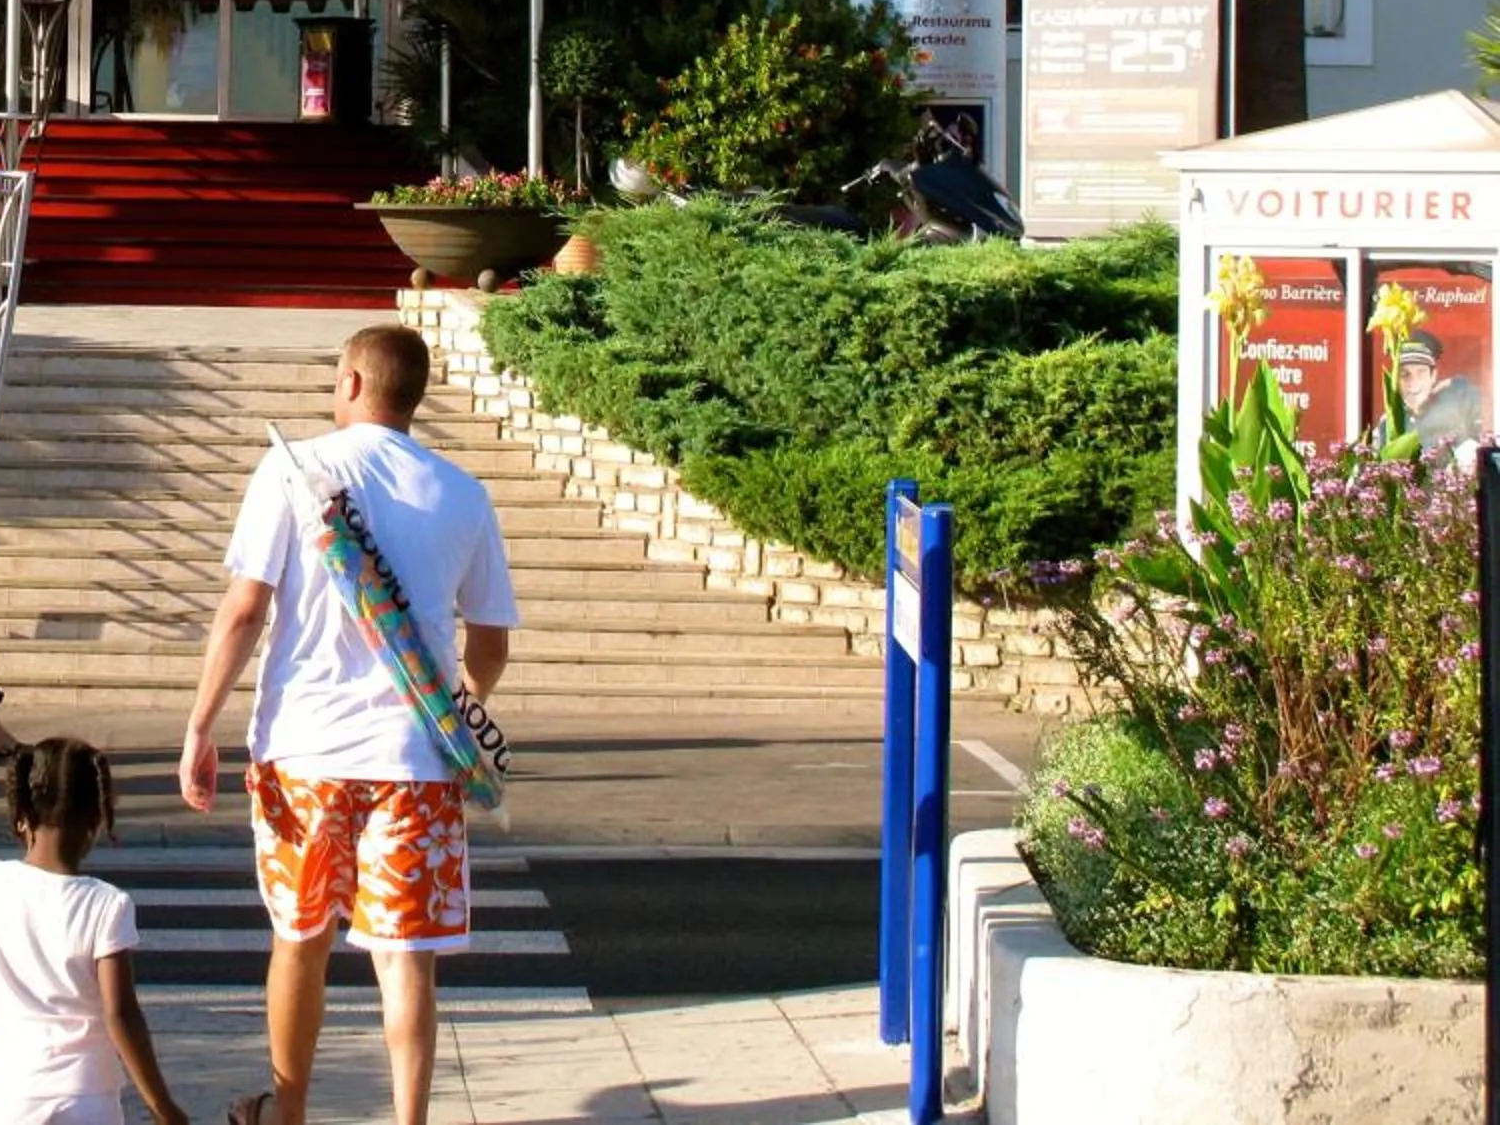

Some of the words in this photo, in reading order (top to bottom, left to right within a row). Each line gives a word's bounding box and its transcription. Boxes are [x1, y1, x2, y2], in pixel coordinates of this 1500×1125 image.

[911, 15, 992, 28] Restaurants
[909, 33, 968, 47] ectacles
[1226, 188, 1473, 221] VOITURIER
[1280, 283, 1342, 302] Barrière
[1238, 338, 1329, 362] Confiez-moi
[1271, 364, 1303, 385] otre
